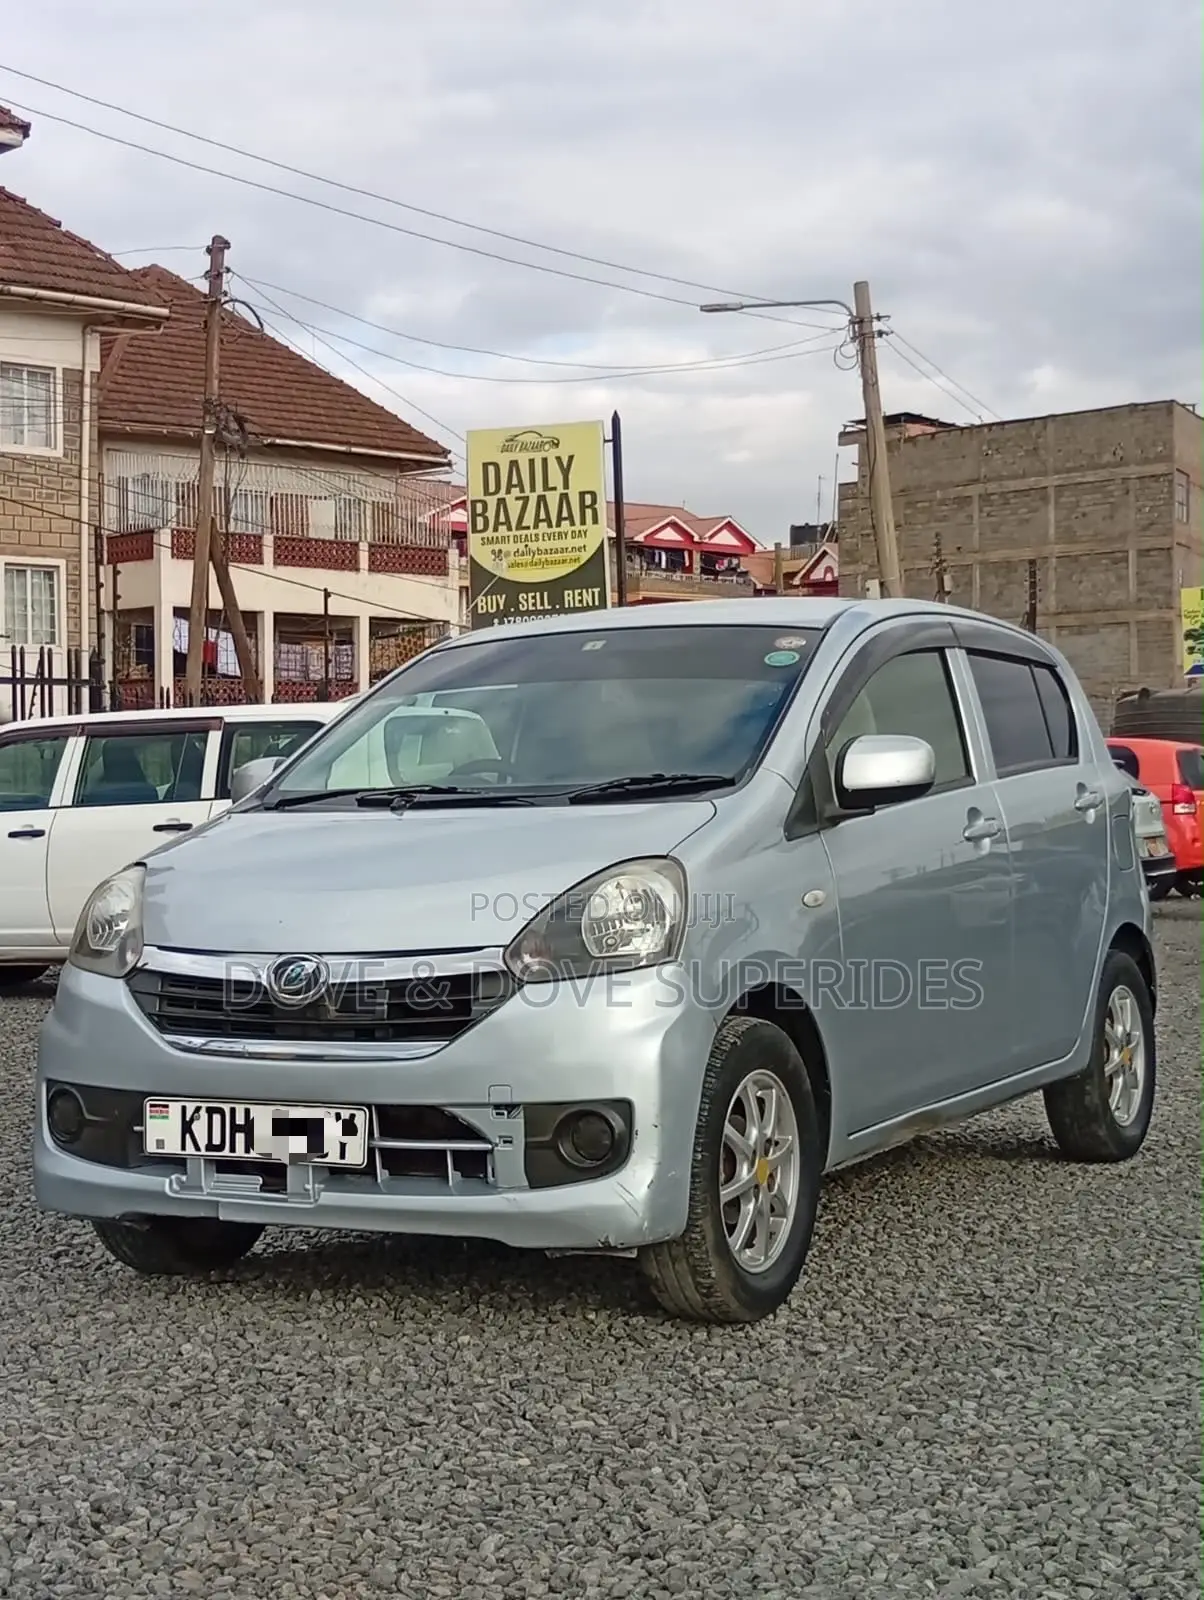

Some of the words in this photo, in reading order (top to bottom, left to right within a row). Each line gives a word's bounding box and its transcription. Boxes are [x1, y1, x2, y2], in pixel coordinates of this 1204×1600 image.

[482, 454, 575, 497] DAILY
[471, 490, 599, 534] BAZAAR
[480, 535, 510, 546] SMART
[513, 533, 540, 545] DEALS
[542, 530, 569, 542] EVERY
[571, 529, 588, 540] DAY
[513, 544, 587, 559] dailybazaar.net
[477, 594, 506, 614] BUY
[518, 591, 552, 611] SELL
[564, 587, 601, 609] RENT
[180, 1104, 252, 1154] KDH
